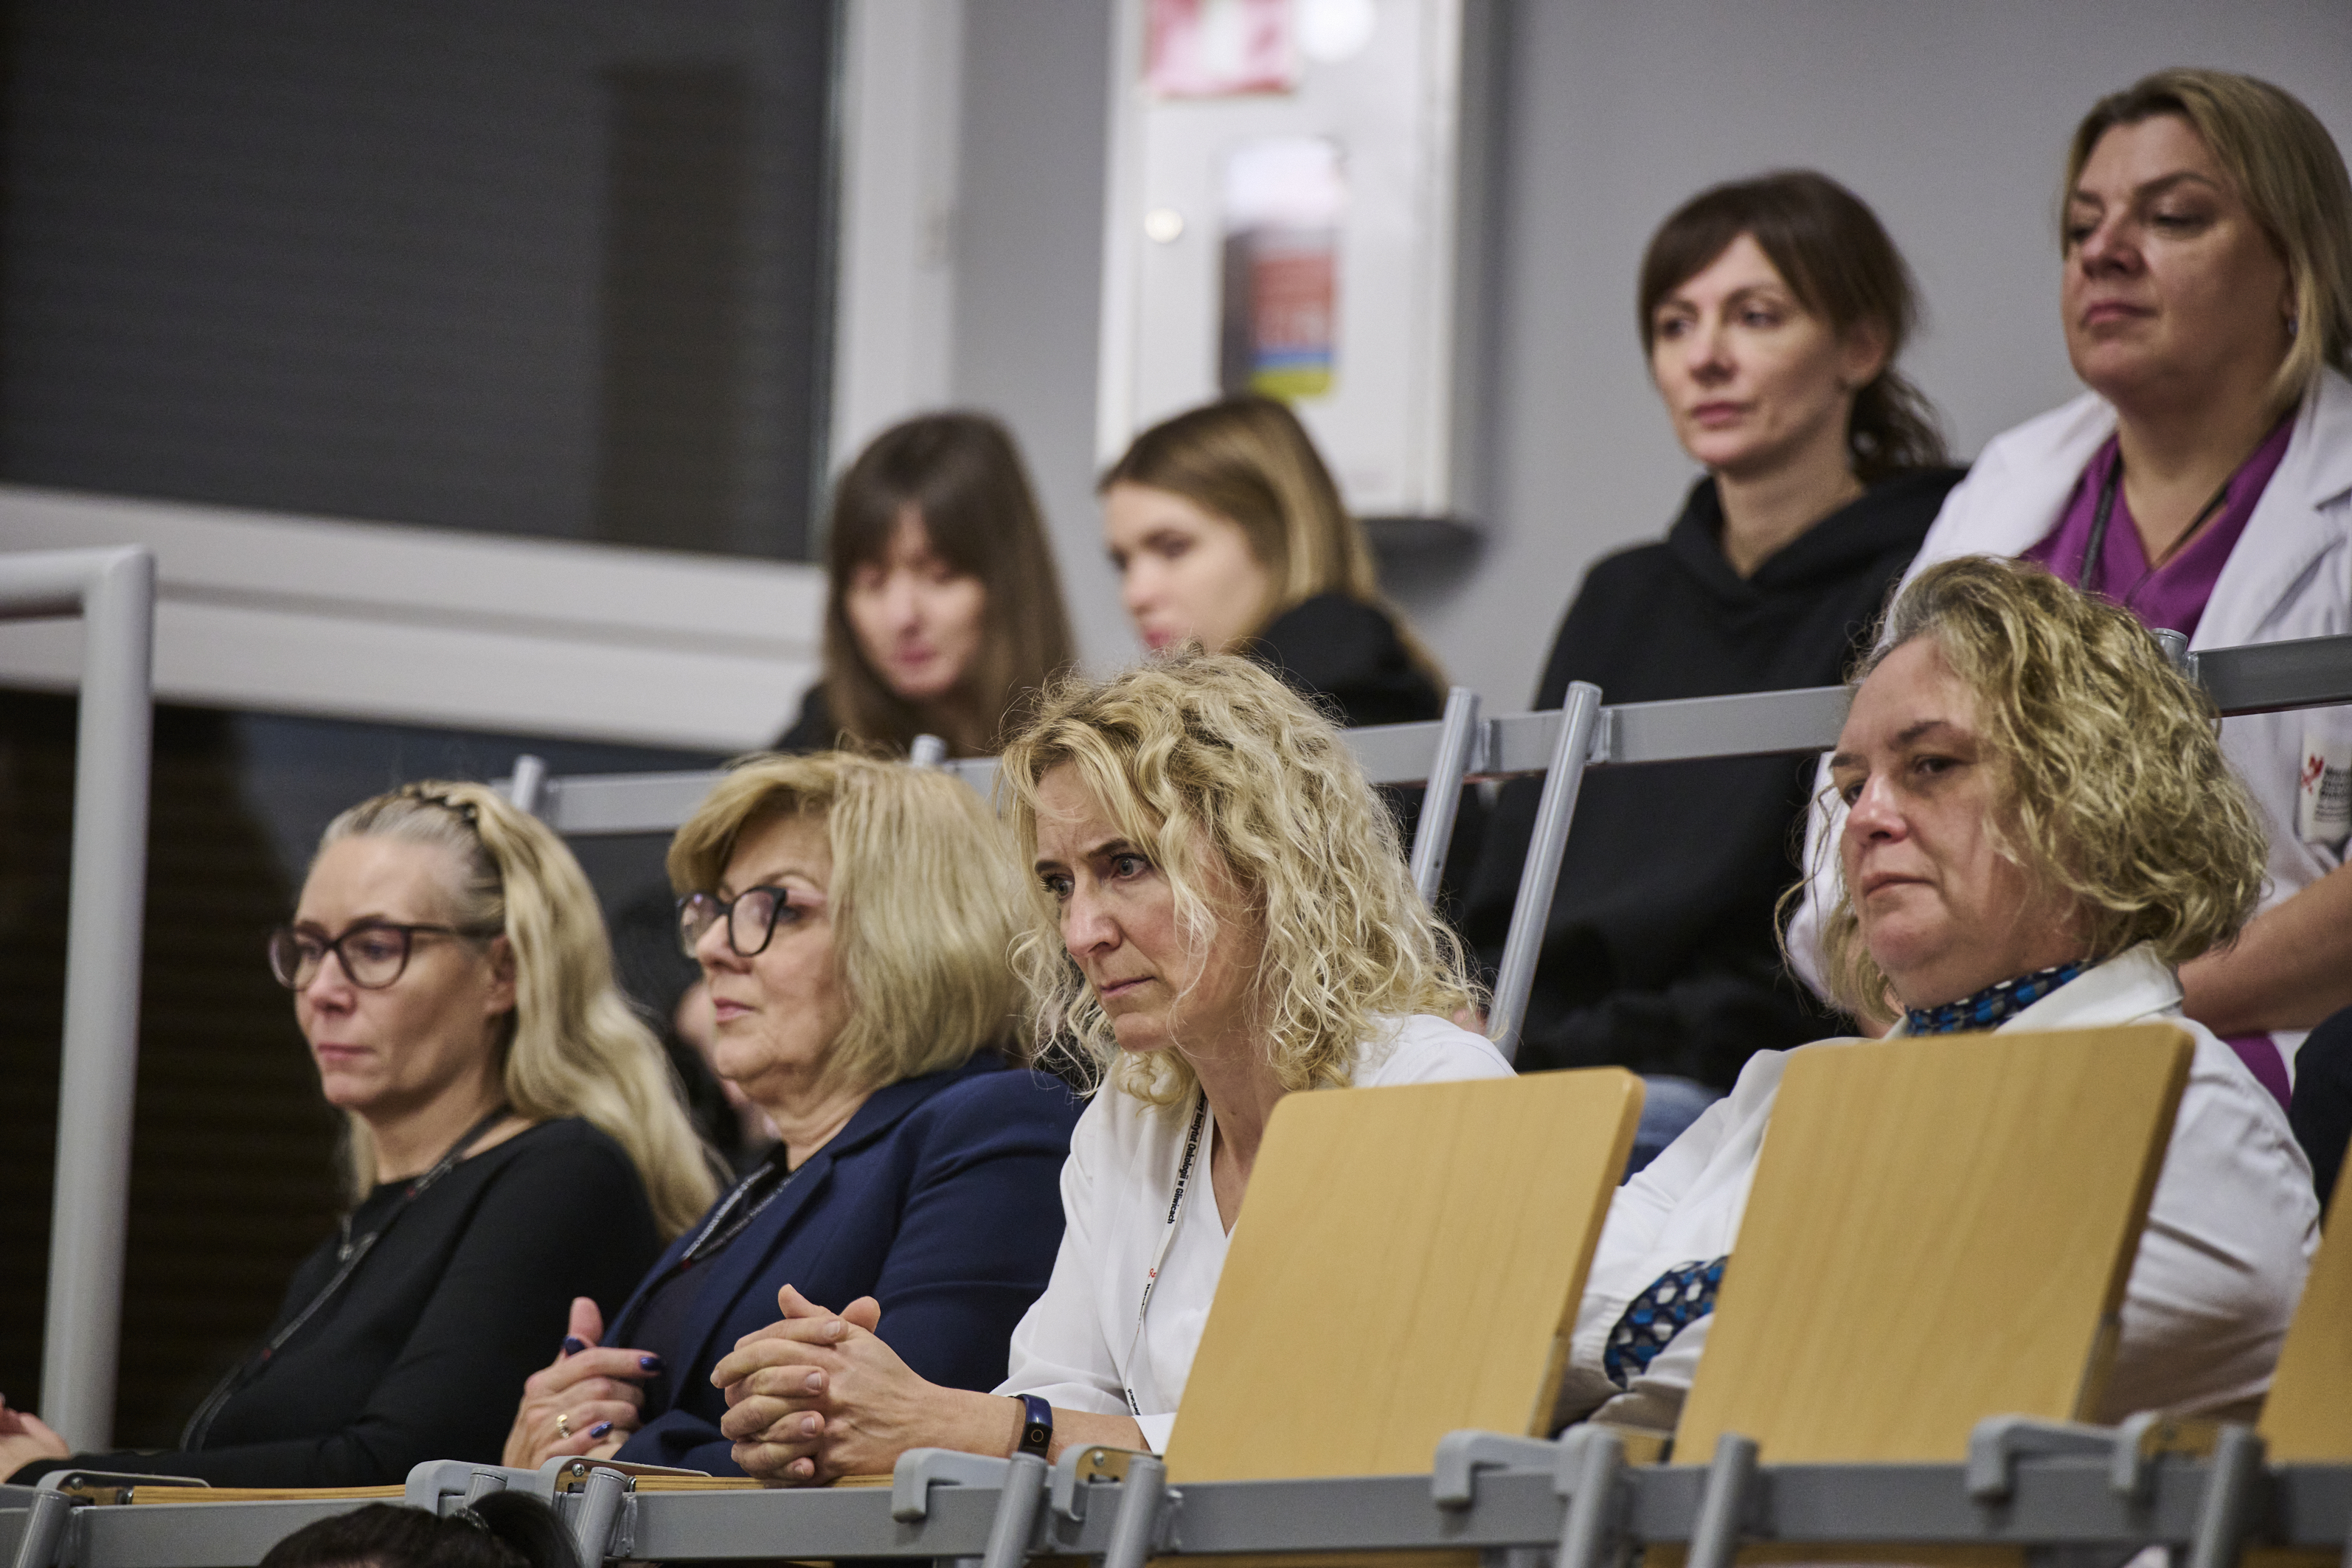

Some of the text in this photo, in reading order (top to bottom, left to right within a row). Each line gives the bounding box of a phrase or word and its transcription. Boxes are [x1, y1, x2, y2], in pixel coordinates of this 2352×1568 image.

[1189, 1113, 1204, 1142] Instytut
[1179, 1143, 1196, 1179] Onkologii
[1167, 1187, 1184, 1224] Gliwicach
